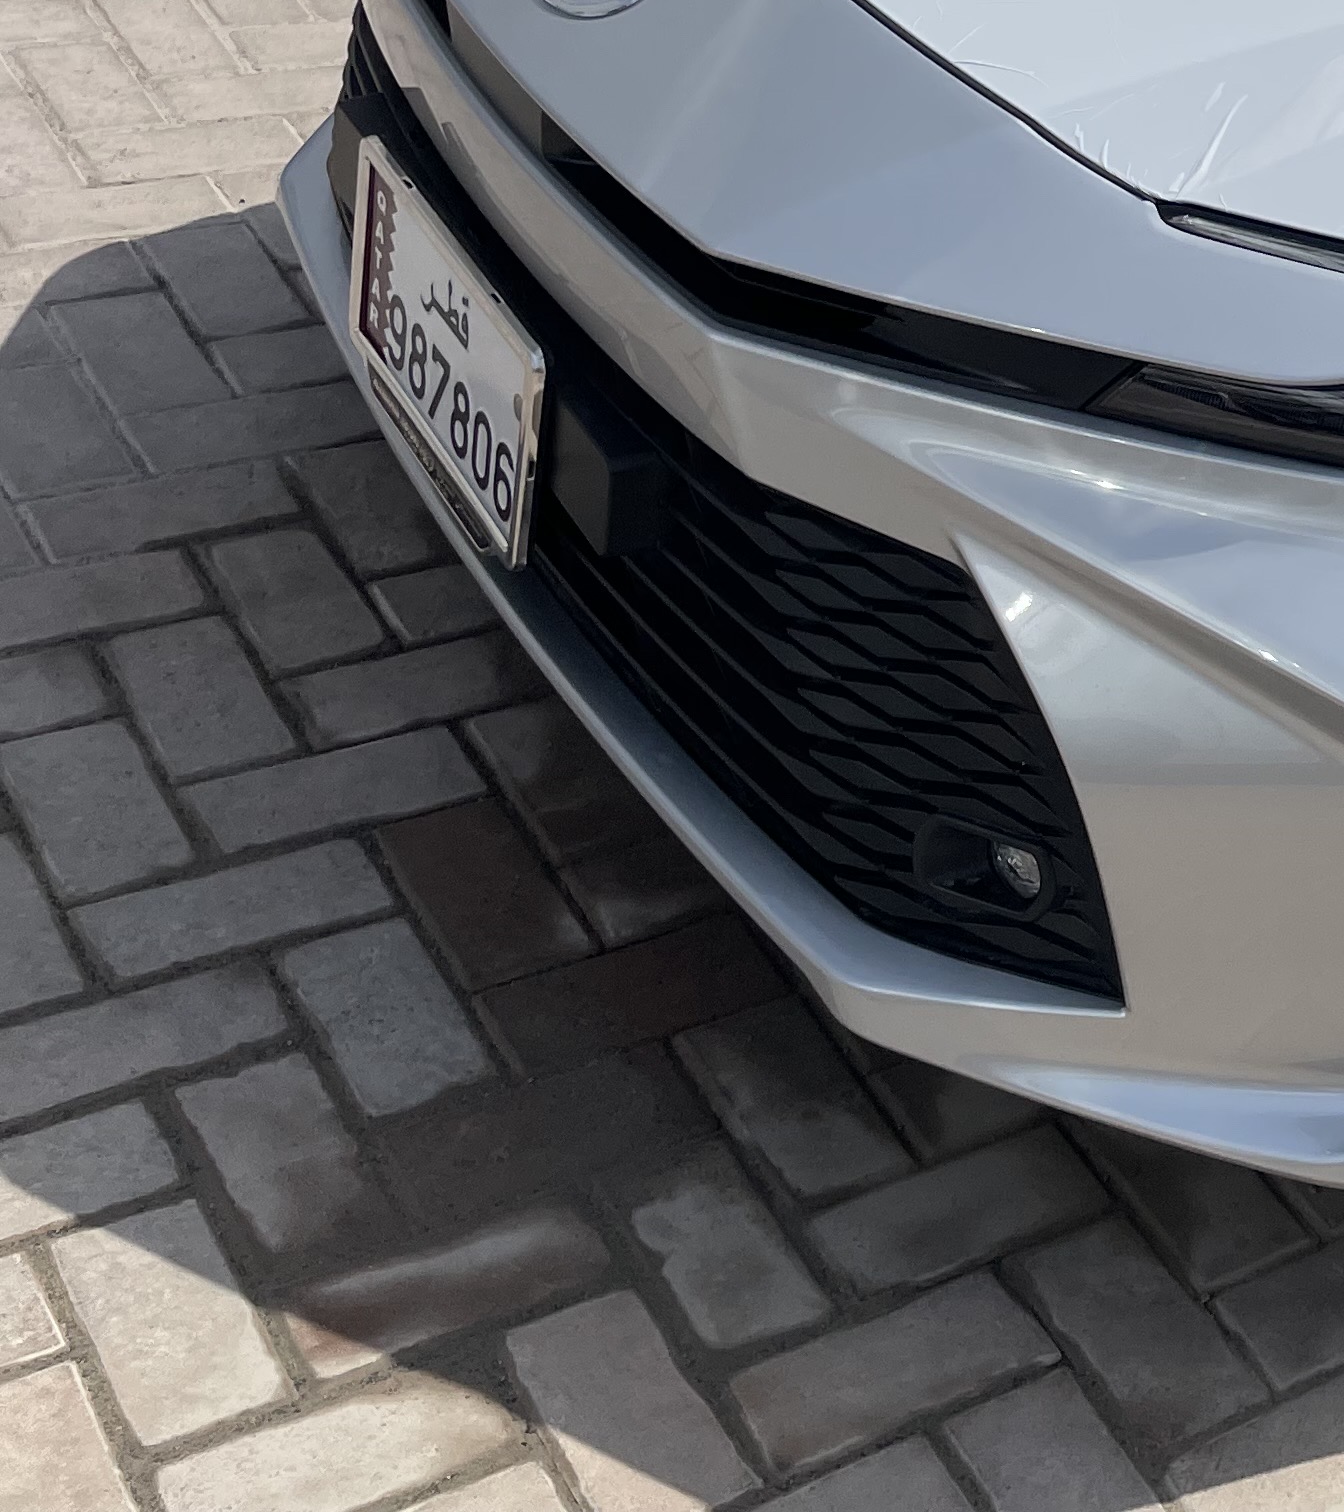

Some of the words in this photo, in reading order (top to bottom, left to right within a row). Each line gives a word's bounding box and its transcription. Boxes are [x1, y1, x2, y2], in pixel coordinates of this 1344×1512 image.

[369, 189, 387, 331] QATAR
[420, 278, 471, 350] قطر
[386, 293, 516, 524] 987806
